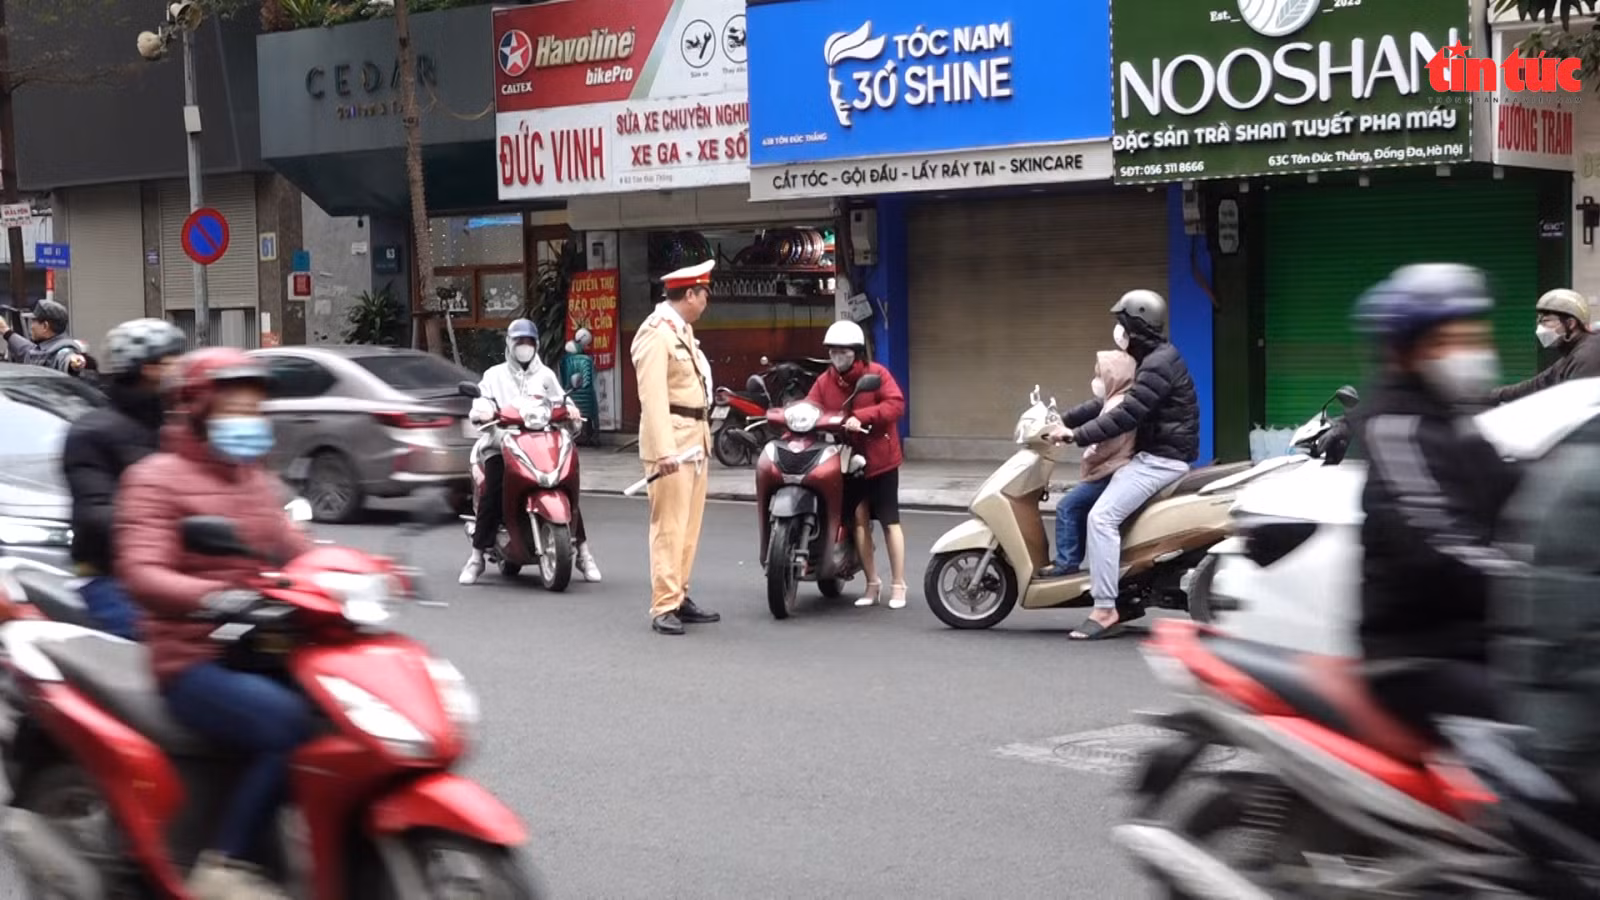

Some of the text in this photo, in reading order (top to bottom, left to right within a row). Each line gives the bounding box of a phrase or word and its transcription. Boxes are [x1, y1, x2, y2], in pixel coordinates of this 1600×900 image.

[535, 28, 634, 68] Havoline
[893, 21, 1012, 60] TÓC NAM
[501, 81, 533, 95] CALTEX
[585, 65, 634, 86] bikePro
[904, 56, 1013, 106] SHINE
[1120, 27, 1458, 119] NOOSHAN
[643, 111, 659, 133] XE
[1112, 105, 1456, 153] ĐẶC SẢN TRÀ SHAN TUYẾT PHA MÁY
[500, 120, 605, 186] ĐỨC VINH
[631, 144, 652, 167] XE
[657, 142, 681, 165] GA
[697, 139, 719, 161] XE
[1178, 161, 1205, 173] 8666
[1268, 155, 1289, 167] 63C
[1291, 152, 1311, 164] Tôn
[1311, 151, 1333, 163] Đức
[1373, 146, 1405, 160] Đống
[1444, 143, 1463, 156] Nội
[801, 170, 828, 187] TÓC
[912, 160, 938, 180] LẤY
[942, 160, 969, 179] RÁY
[973, 161, 995, 176] TAI
[1010, 154, 1084, 173] SKINCARE
